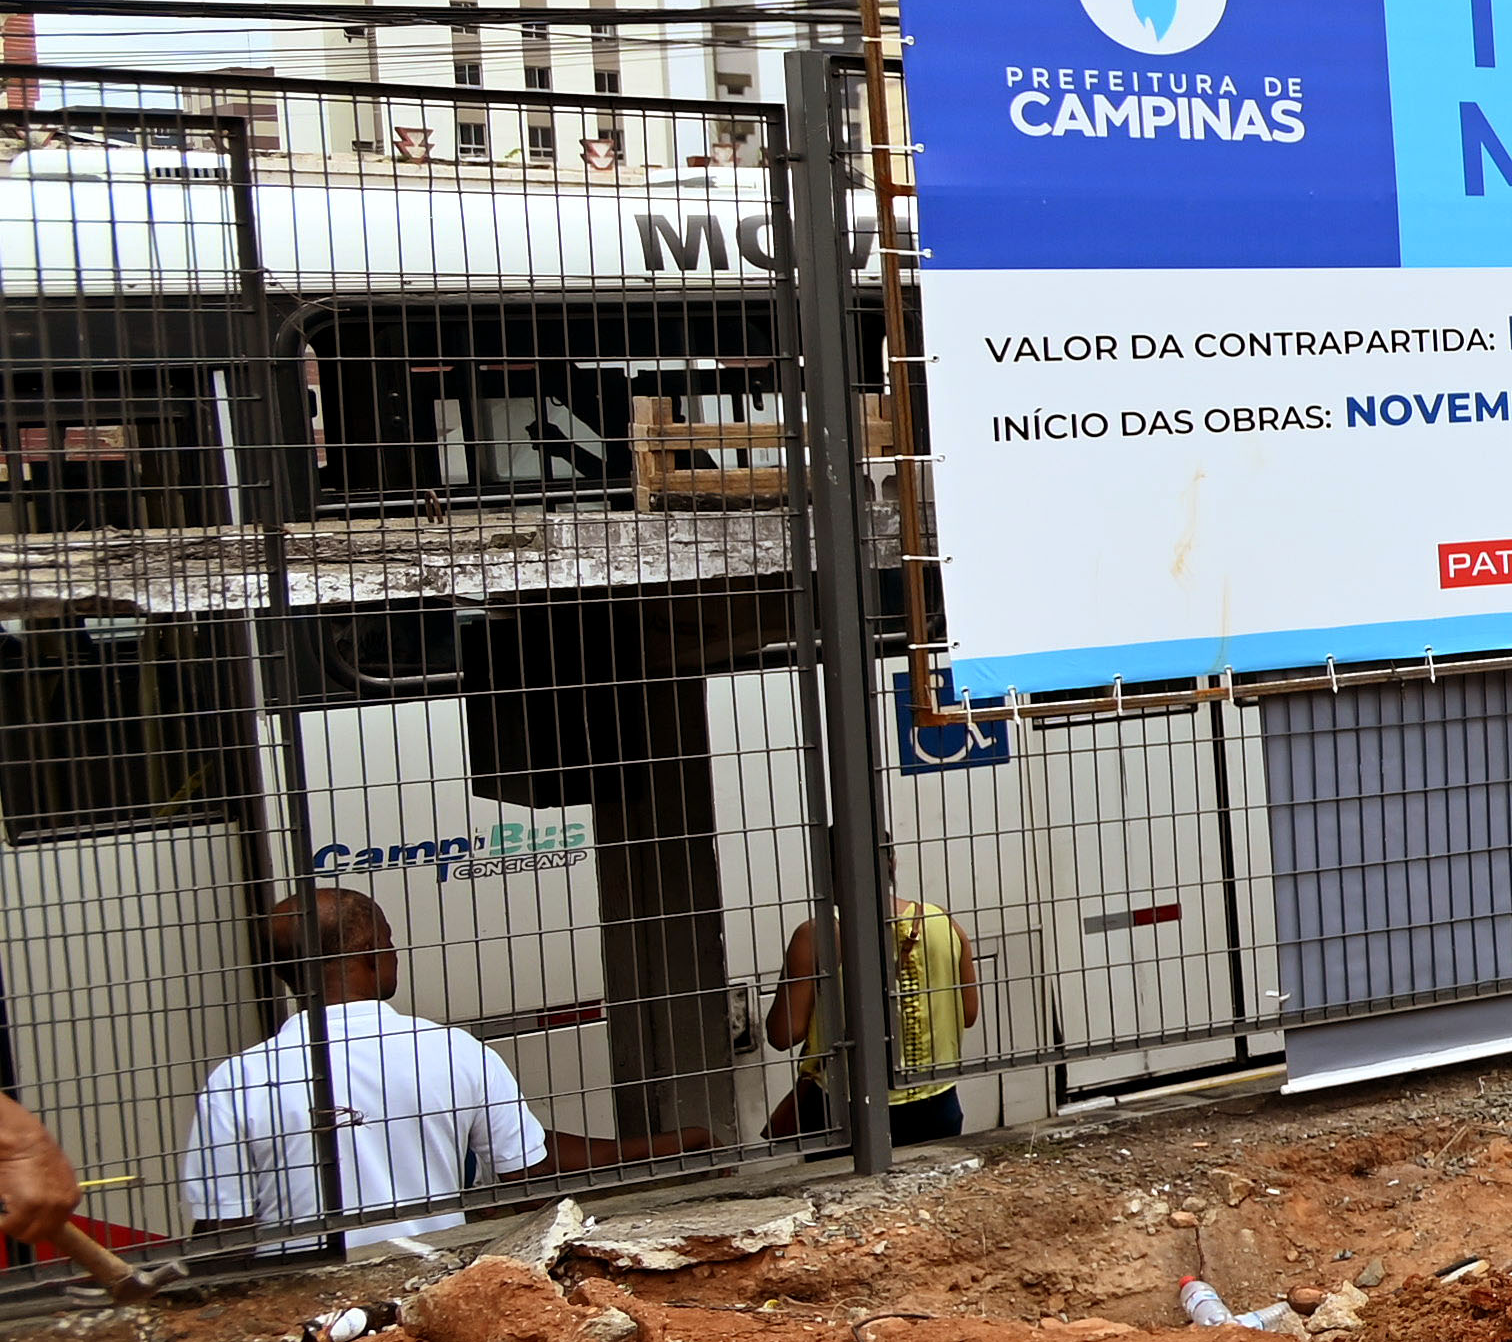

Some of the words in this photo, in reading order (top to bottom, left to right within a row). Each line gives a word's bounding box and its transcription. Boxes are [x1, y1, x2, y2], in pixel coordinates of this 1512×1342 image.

[1006, 66, 1238, 96] PREFEITURA
[1264, 76, 1303, 98] DE
[1009, 90, 1305, 144] CAMPINAS
[984, 335, 1118, 363] VALOR
[1131, 334, 1185, 360] DA
[1194, 327, 1495, 358] CONTRAPARTIDA:
[993, 407, 1109, 443] INÍCIO
[1121, 409, 1194, 437] DAS
[1204, 405, 1332, 433] OBRAS:
[453, 850, 588, 881] CONCICAMP
